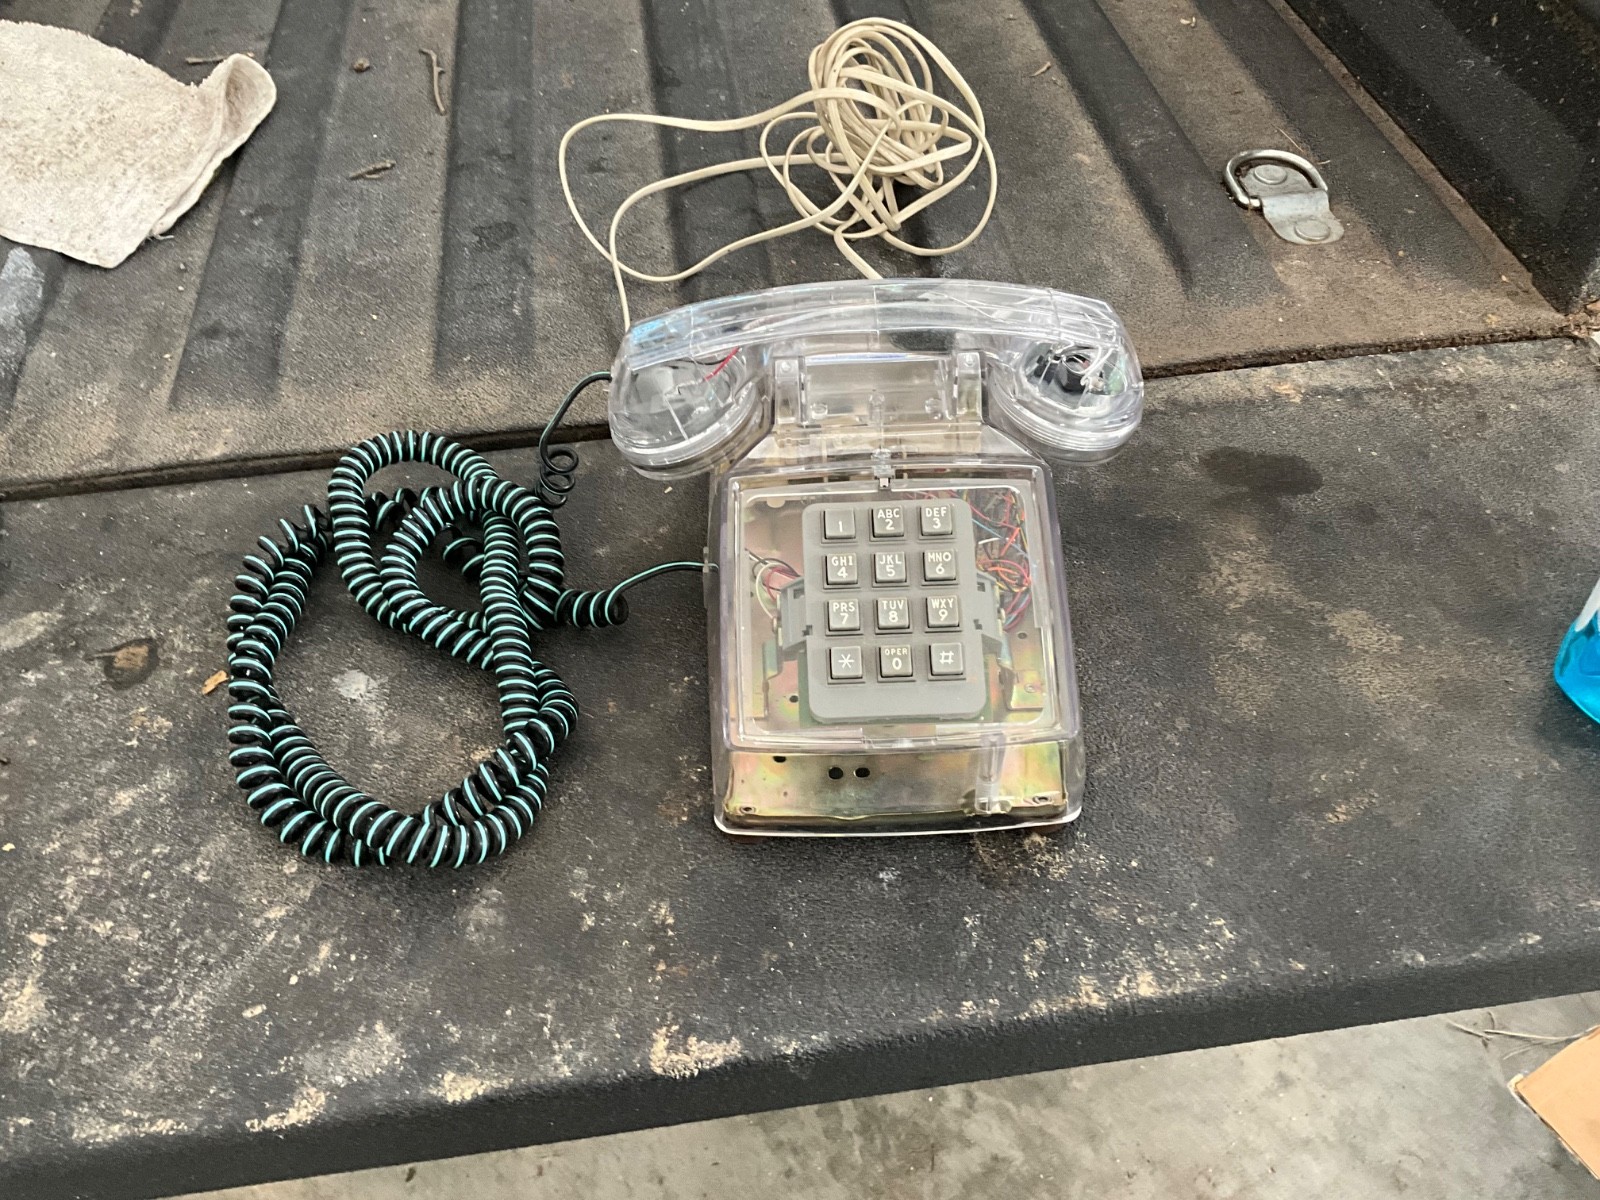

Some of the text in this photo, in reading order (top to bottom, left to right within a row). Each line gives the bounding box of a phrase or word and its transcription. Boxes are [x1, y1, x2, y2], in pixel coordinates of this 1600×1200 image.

[877, 508, 900, 518] ABC
[925, 507, 947, 517] DEF
[838, 520, 843, 532] 1
[885, 519, 895, 530] 2
[932, 517, 942, 529] 3
[831, 555, 853, 566] GHI
[879, 554, 902, 565] JKL
[927, 552, 952, 562] MNO
[837, 567, 848, 578] 4
[885, 565, 896, 577] 5
[935, 563, 945, 575] 6
[832, 602, 855, 612] PRS
[882, 600, 904, 610] TUV
[931, 599, 954, 609] WXY
[840, 613, 849, 625] 7
[888, 610, 898, 623] 8
[938, 609, 948, 621] 9
[884, 648, 907, 656] OPER
[891, 657, 902, 670] 0
